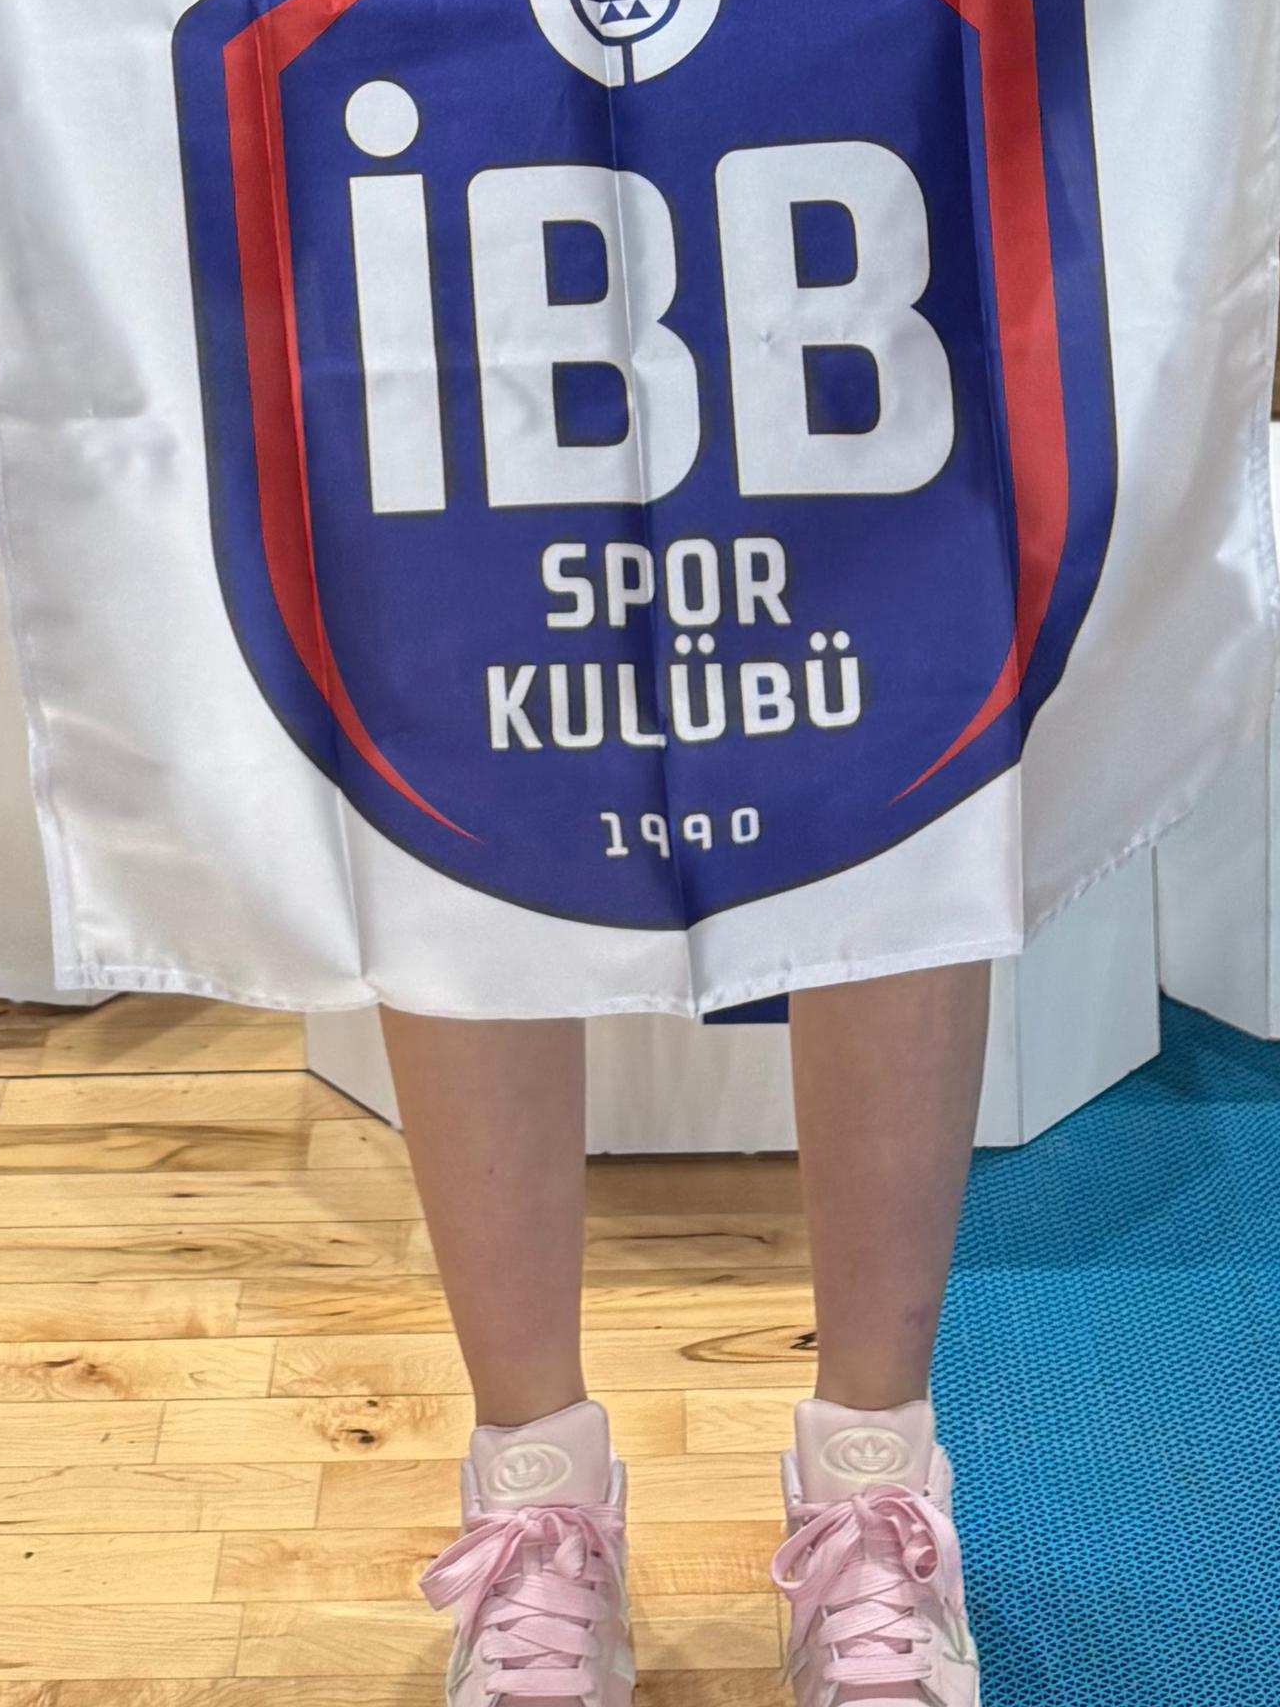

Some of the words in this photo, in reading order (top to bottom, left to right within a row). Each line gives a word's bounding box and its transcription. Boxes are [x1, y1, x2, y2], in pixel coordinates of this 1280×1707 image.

[343, 78, 959, 516] İBB
[540, 537, 791, 630] SPOR
[485, 630, 865, 751] KULÜBÜ
[600, 805, 762, 861] 1990
